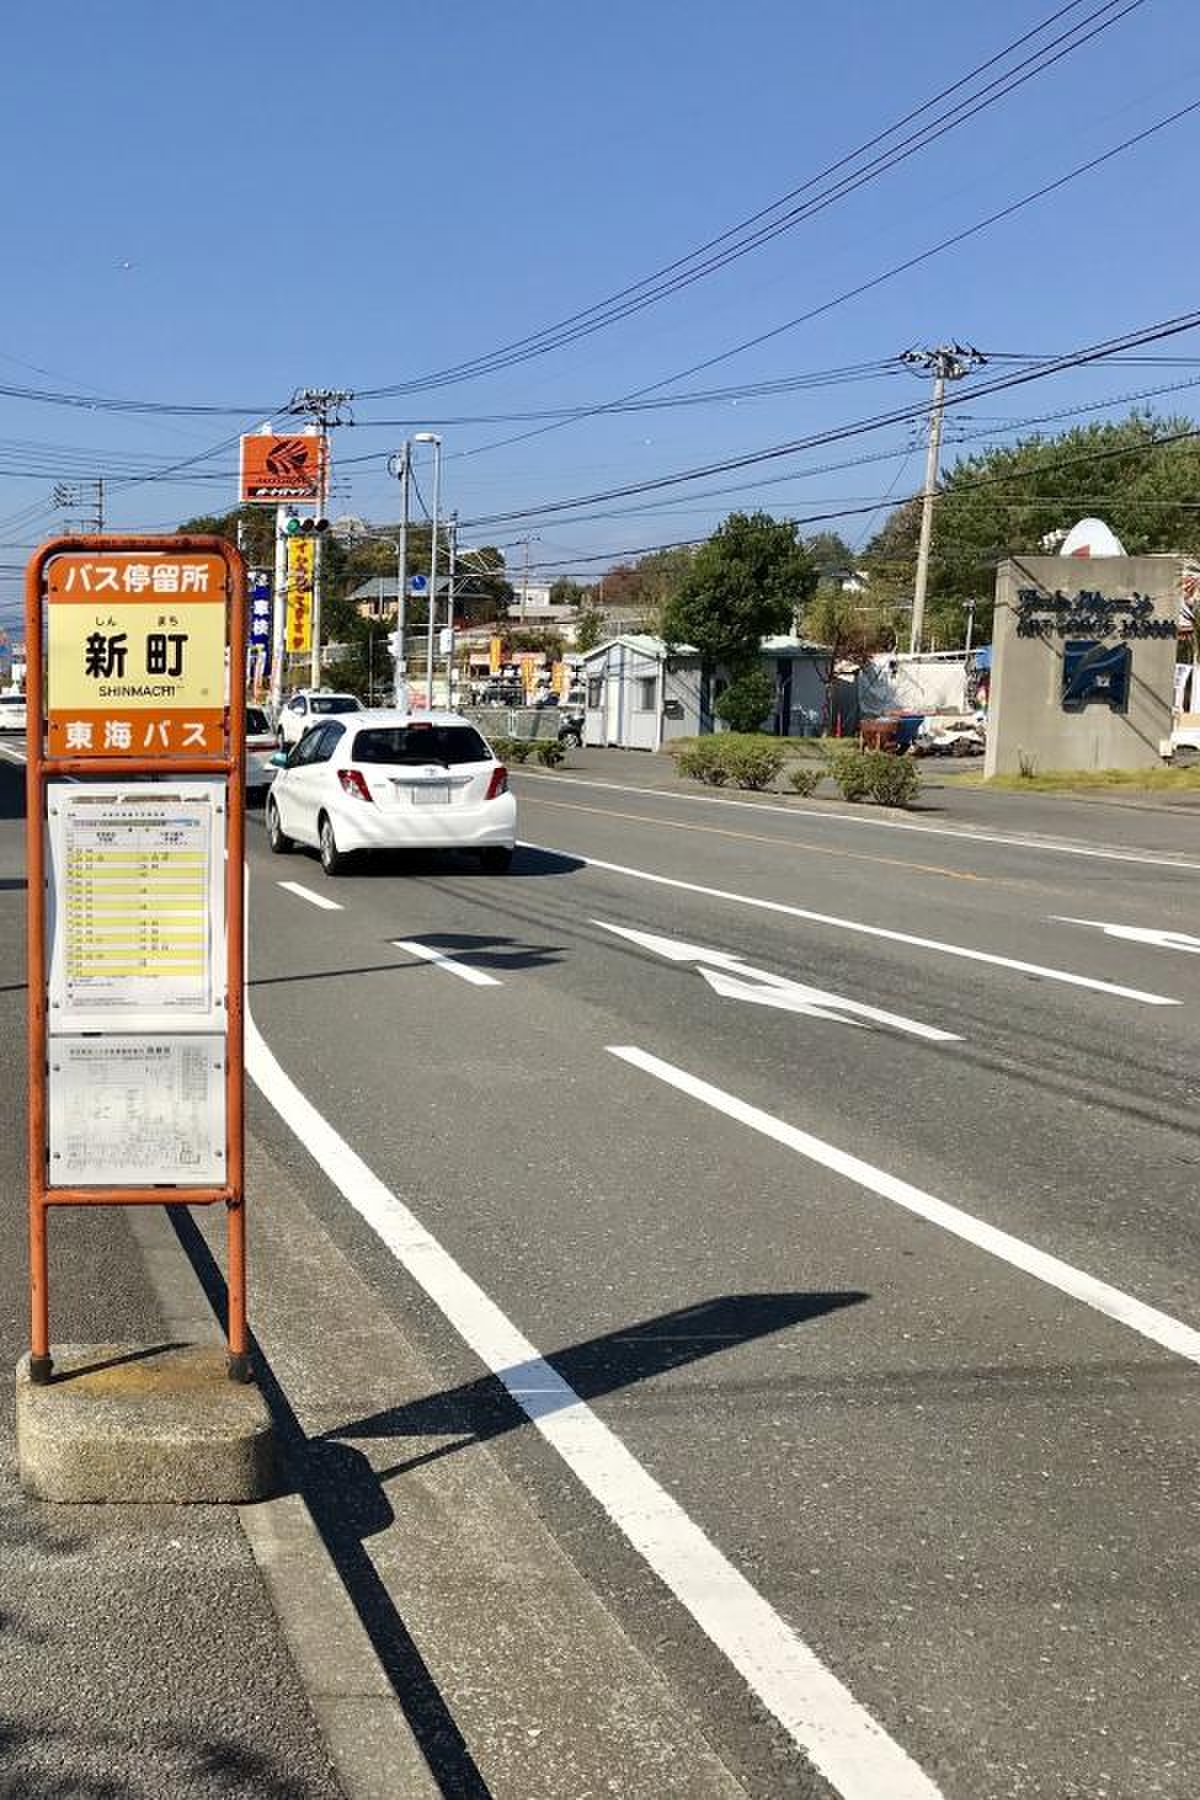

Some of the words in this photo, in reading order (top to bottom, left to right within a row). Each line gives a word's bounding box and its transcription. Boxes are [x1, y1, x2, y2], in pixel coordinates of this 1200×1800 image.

[64, 564, 209, 593] バス停留所
[85, 632, 189, 679] 新町
[98, 685, 177, 698] SHINMACHI
[64, 720, 208, 750] 東海バス
